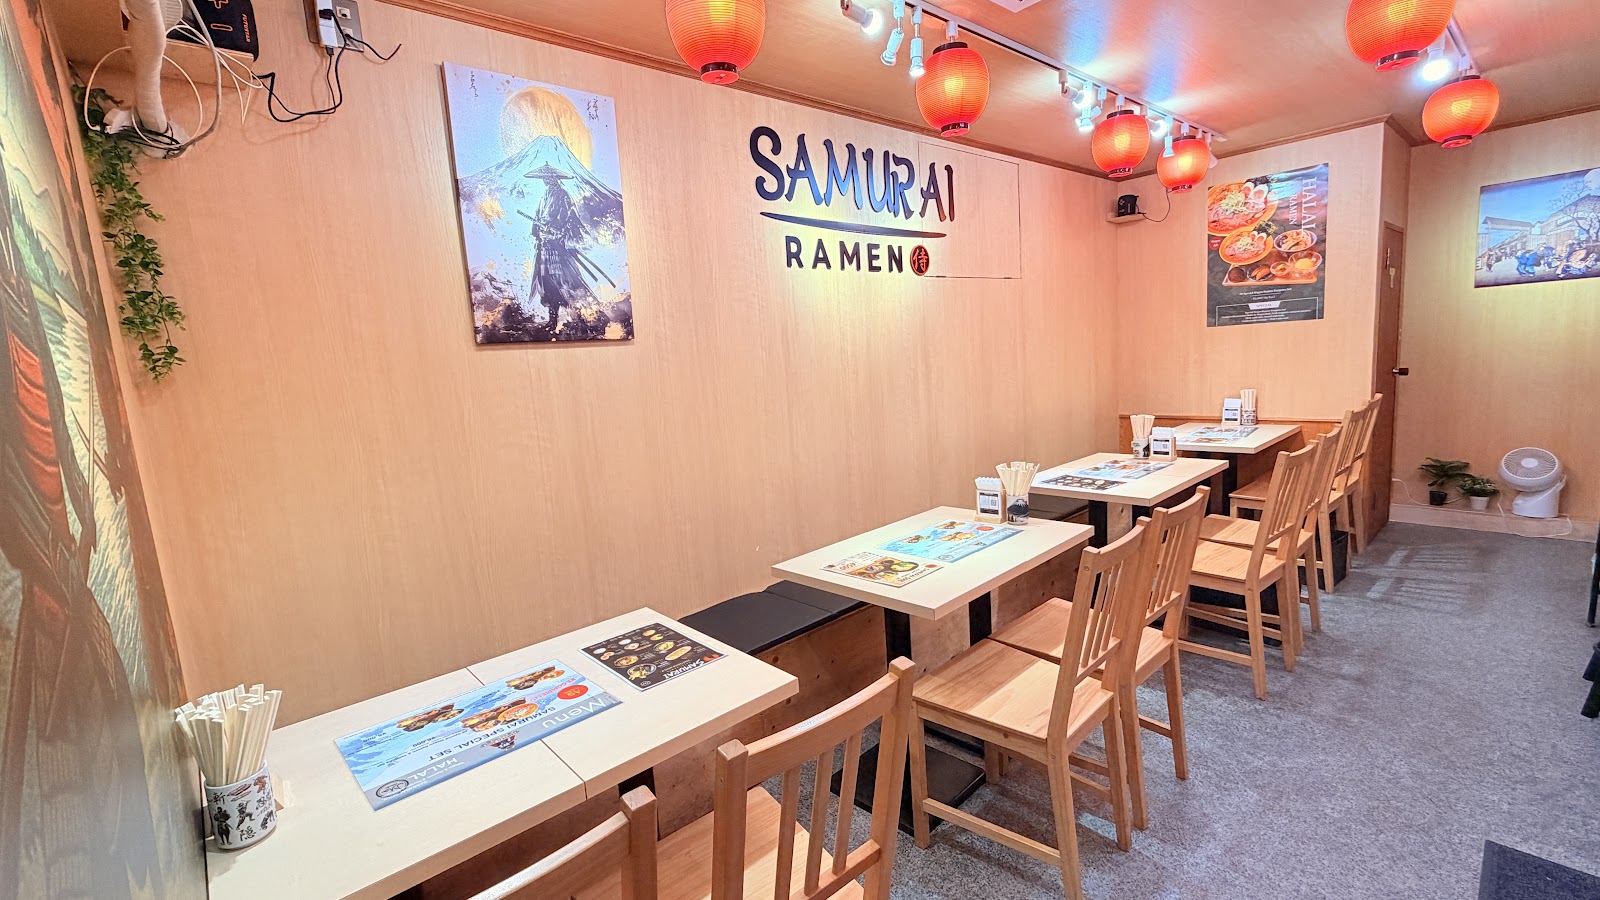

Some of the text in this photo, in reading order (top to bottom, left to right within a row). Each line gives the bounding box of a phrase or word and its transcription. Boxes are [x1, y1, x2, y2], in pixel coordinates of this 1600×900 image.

[750, 126, 955, 222] SAMURAI
[1289, 194, 1297, 225] RAMEN
[785, 236, 904, 273] RAMEN
[912, 248, 929, 273] 侍
[663, 659, 704, 679] SAMURAI
[506, 706, 556, 729] SAMURAI
[542, 698, 607, 728] Menu
[453, 727, 505, 749] SPECIAL
[429, 749, 452, 762] SET
[408, 757, 458, 779] HALAL
